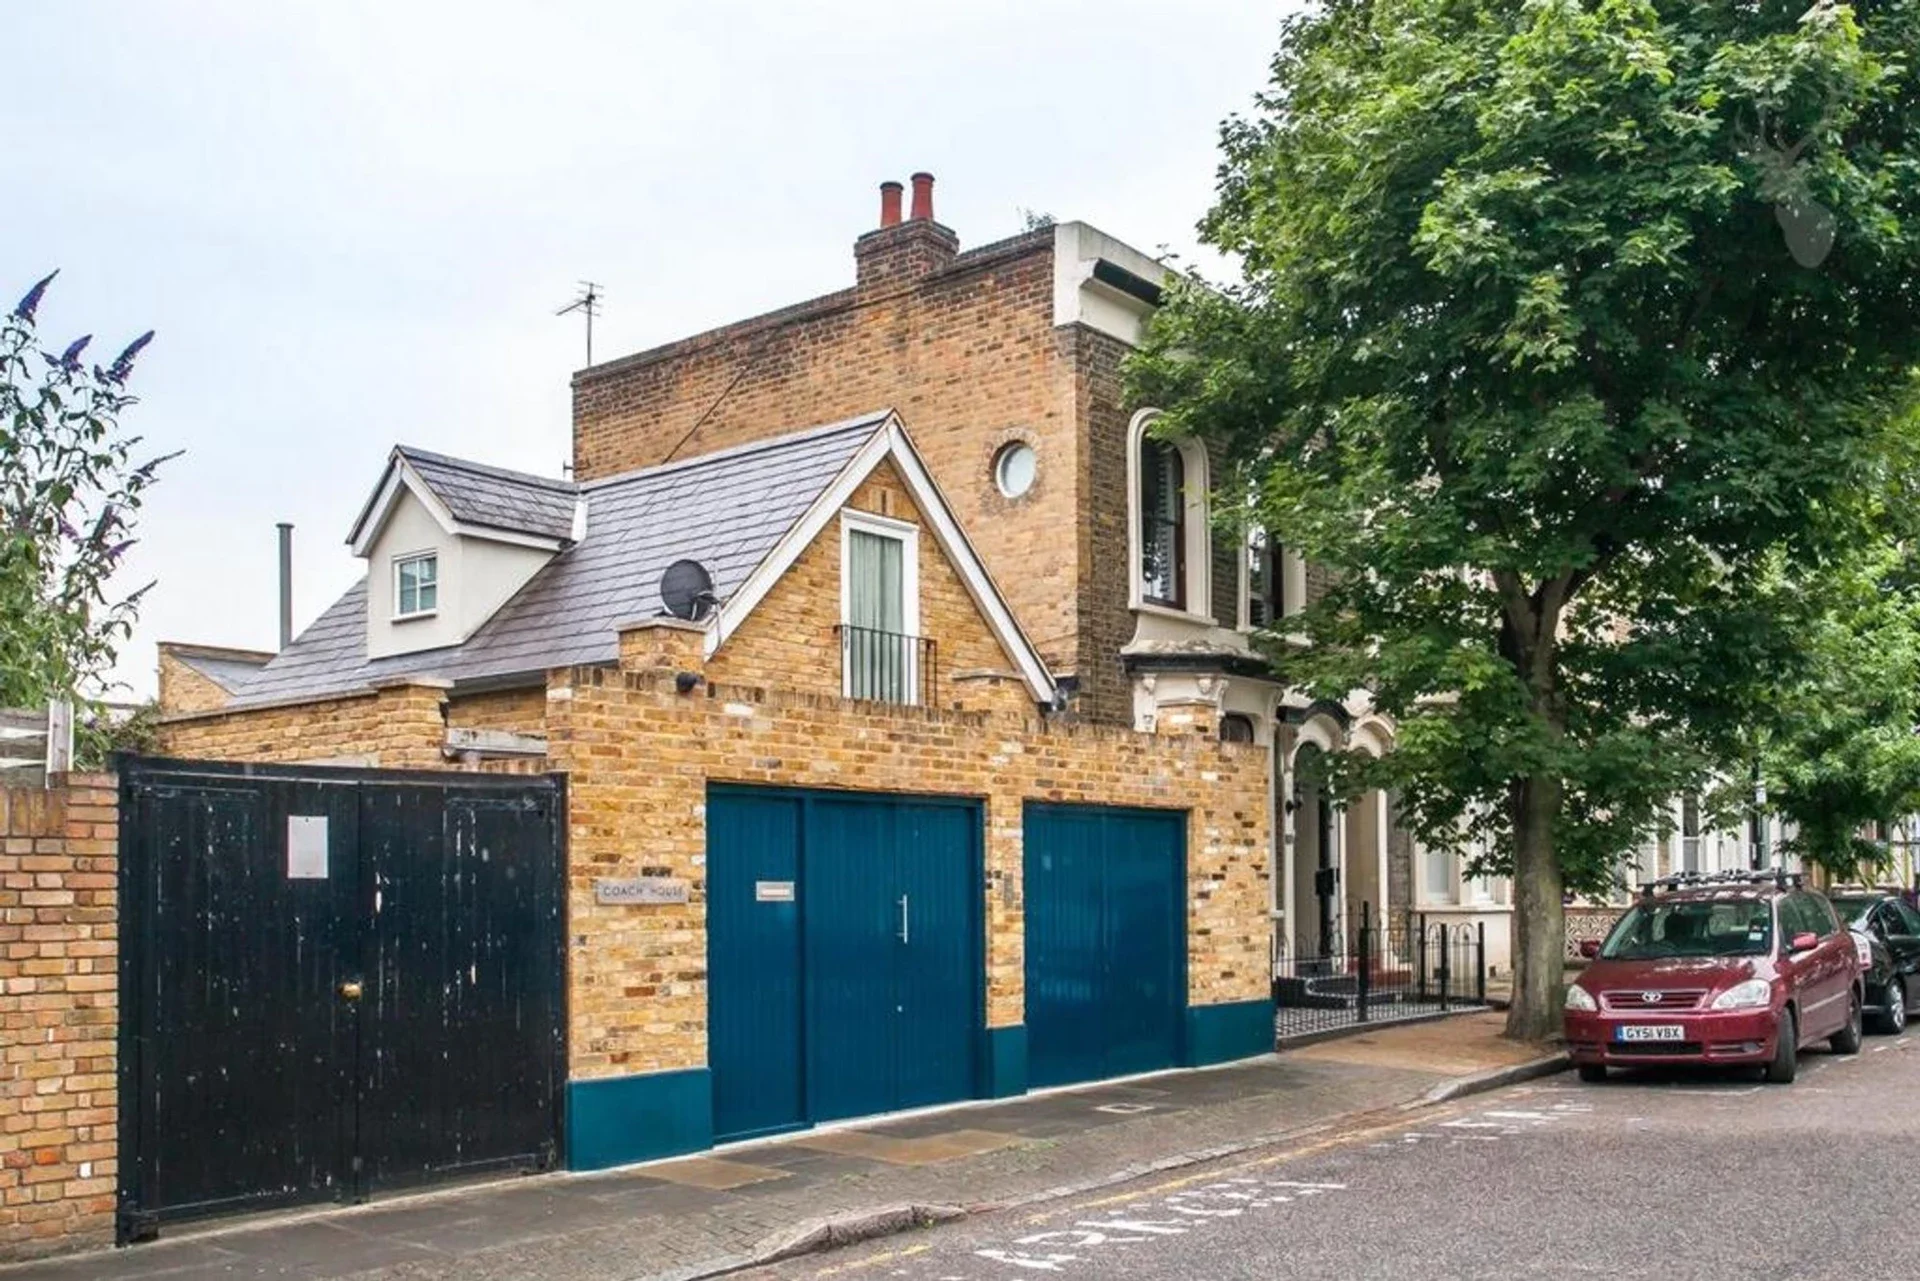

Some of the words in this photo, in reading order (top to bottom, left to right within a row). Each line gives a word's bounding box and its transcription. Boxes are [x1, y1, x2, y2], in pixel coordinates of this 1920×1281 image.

[603, 885, 643, 897] COACH
[650, 885, 684, 897] HOUSE
[1656, 1027, 1680, 1039] VBX
